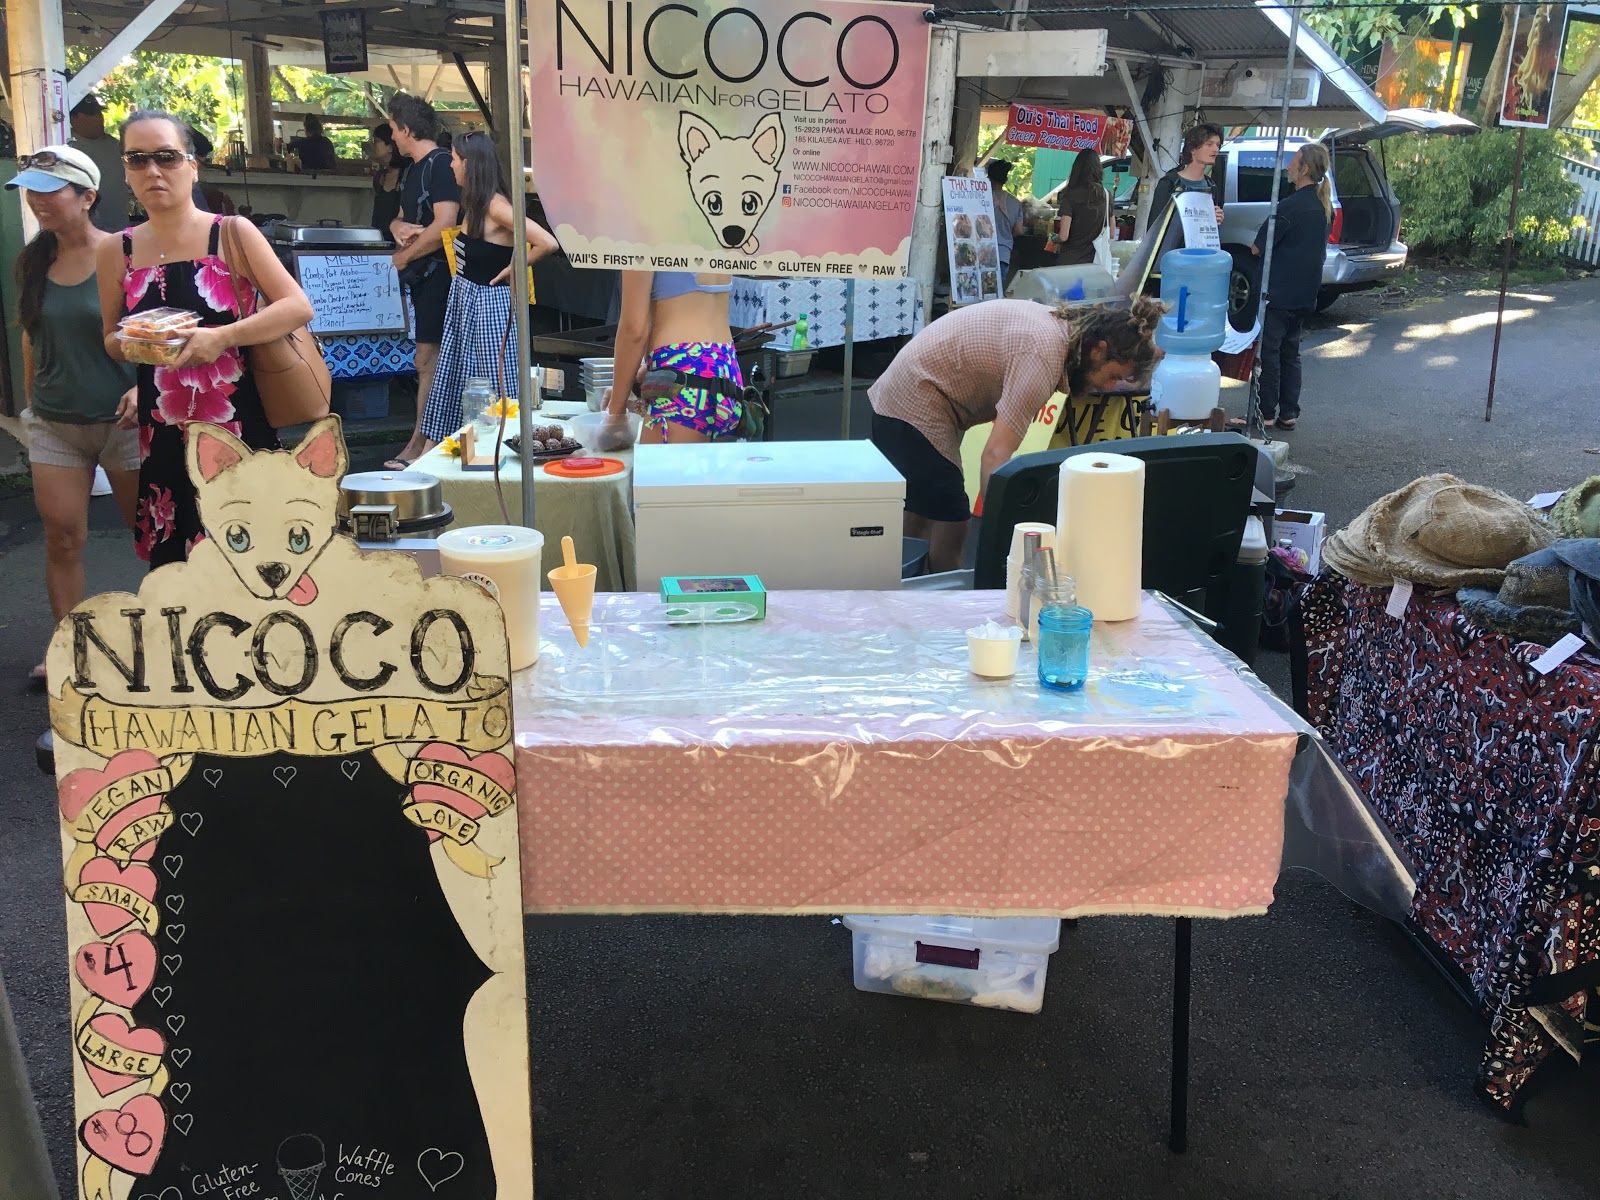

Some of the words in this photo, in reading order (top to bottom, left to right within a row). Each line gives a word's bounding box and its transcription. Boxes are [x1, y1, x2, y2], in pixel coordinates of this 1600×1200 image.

[555, 0, 900, 90] NICOCO
[559, 75, 717, 105] HAWAIIAN
[757, 88, 889, 114] GELATO
[793, 115, 807, 123] Visit
[794, 126, 820, 134] 15-2929
[1046, 111, 1070, 130] Thai
[1073, 114, 1099, 134] Food
[1008, 128, 1037, 143] Green
[1039, 130, 1073, 148] Papaya
[792, 161, 915, 175] WWW.NICOCOHAWAII.COM
[948, 179, 968, 191] THAI
[970, 180, 988, 192] FOOD
[603, 254, 634, 266] FIRST
[650, 256, 688, 268] VEGAN
[709, 258, 757, 270] ORGANIC
[778, 261, 821, 273] GLUTEN
[826, 263, 853, 274] FREE
[872, 265, 896, 276] RAW
[69, 606, 476, 702] NICOCO
[86, 707, 297, 752] HAWAIIAN
[312, 703, 508, 752] GELATO
[414, 762, 507, 811] ORGANIC
[77, 773, 163, 834] VEGAN
[113, 815, 167, 853] RAW
[412, 808, 474, 838] LOVE
[84, 885, 151, 924] SMALL
[82, 1034, 149, 1073] LARGE
[338, 1143, 395, 1176] Waffle
[191, 1162, 259, 1195] Gluten-
[223, 1180, 261, 1200] Free
[334, 1165, 381, 1188] Cones
